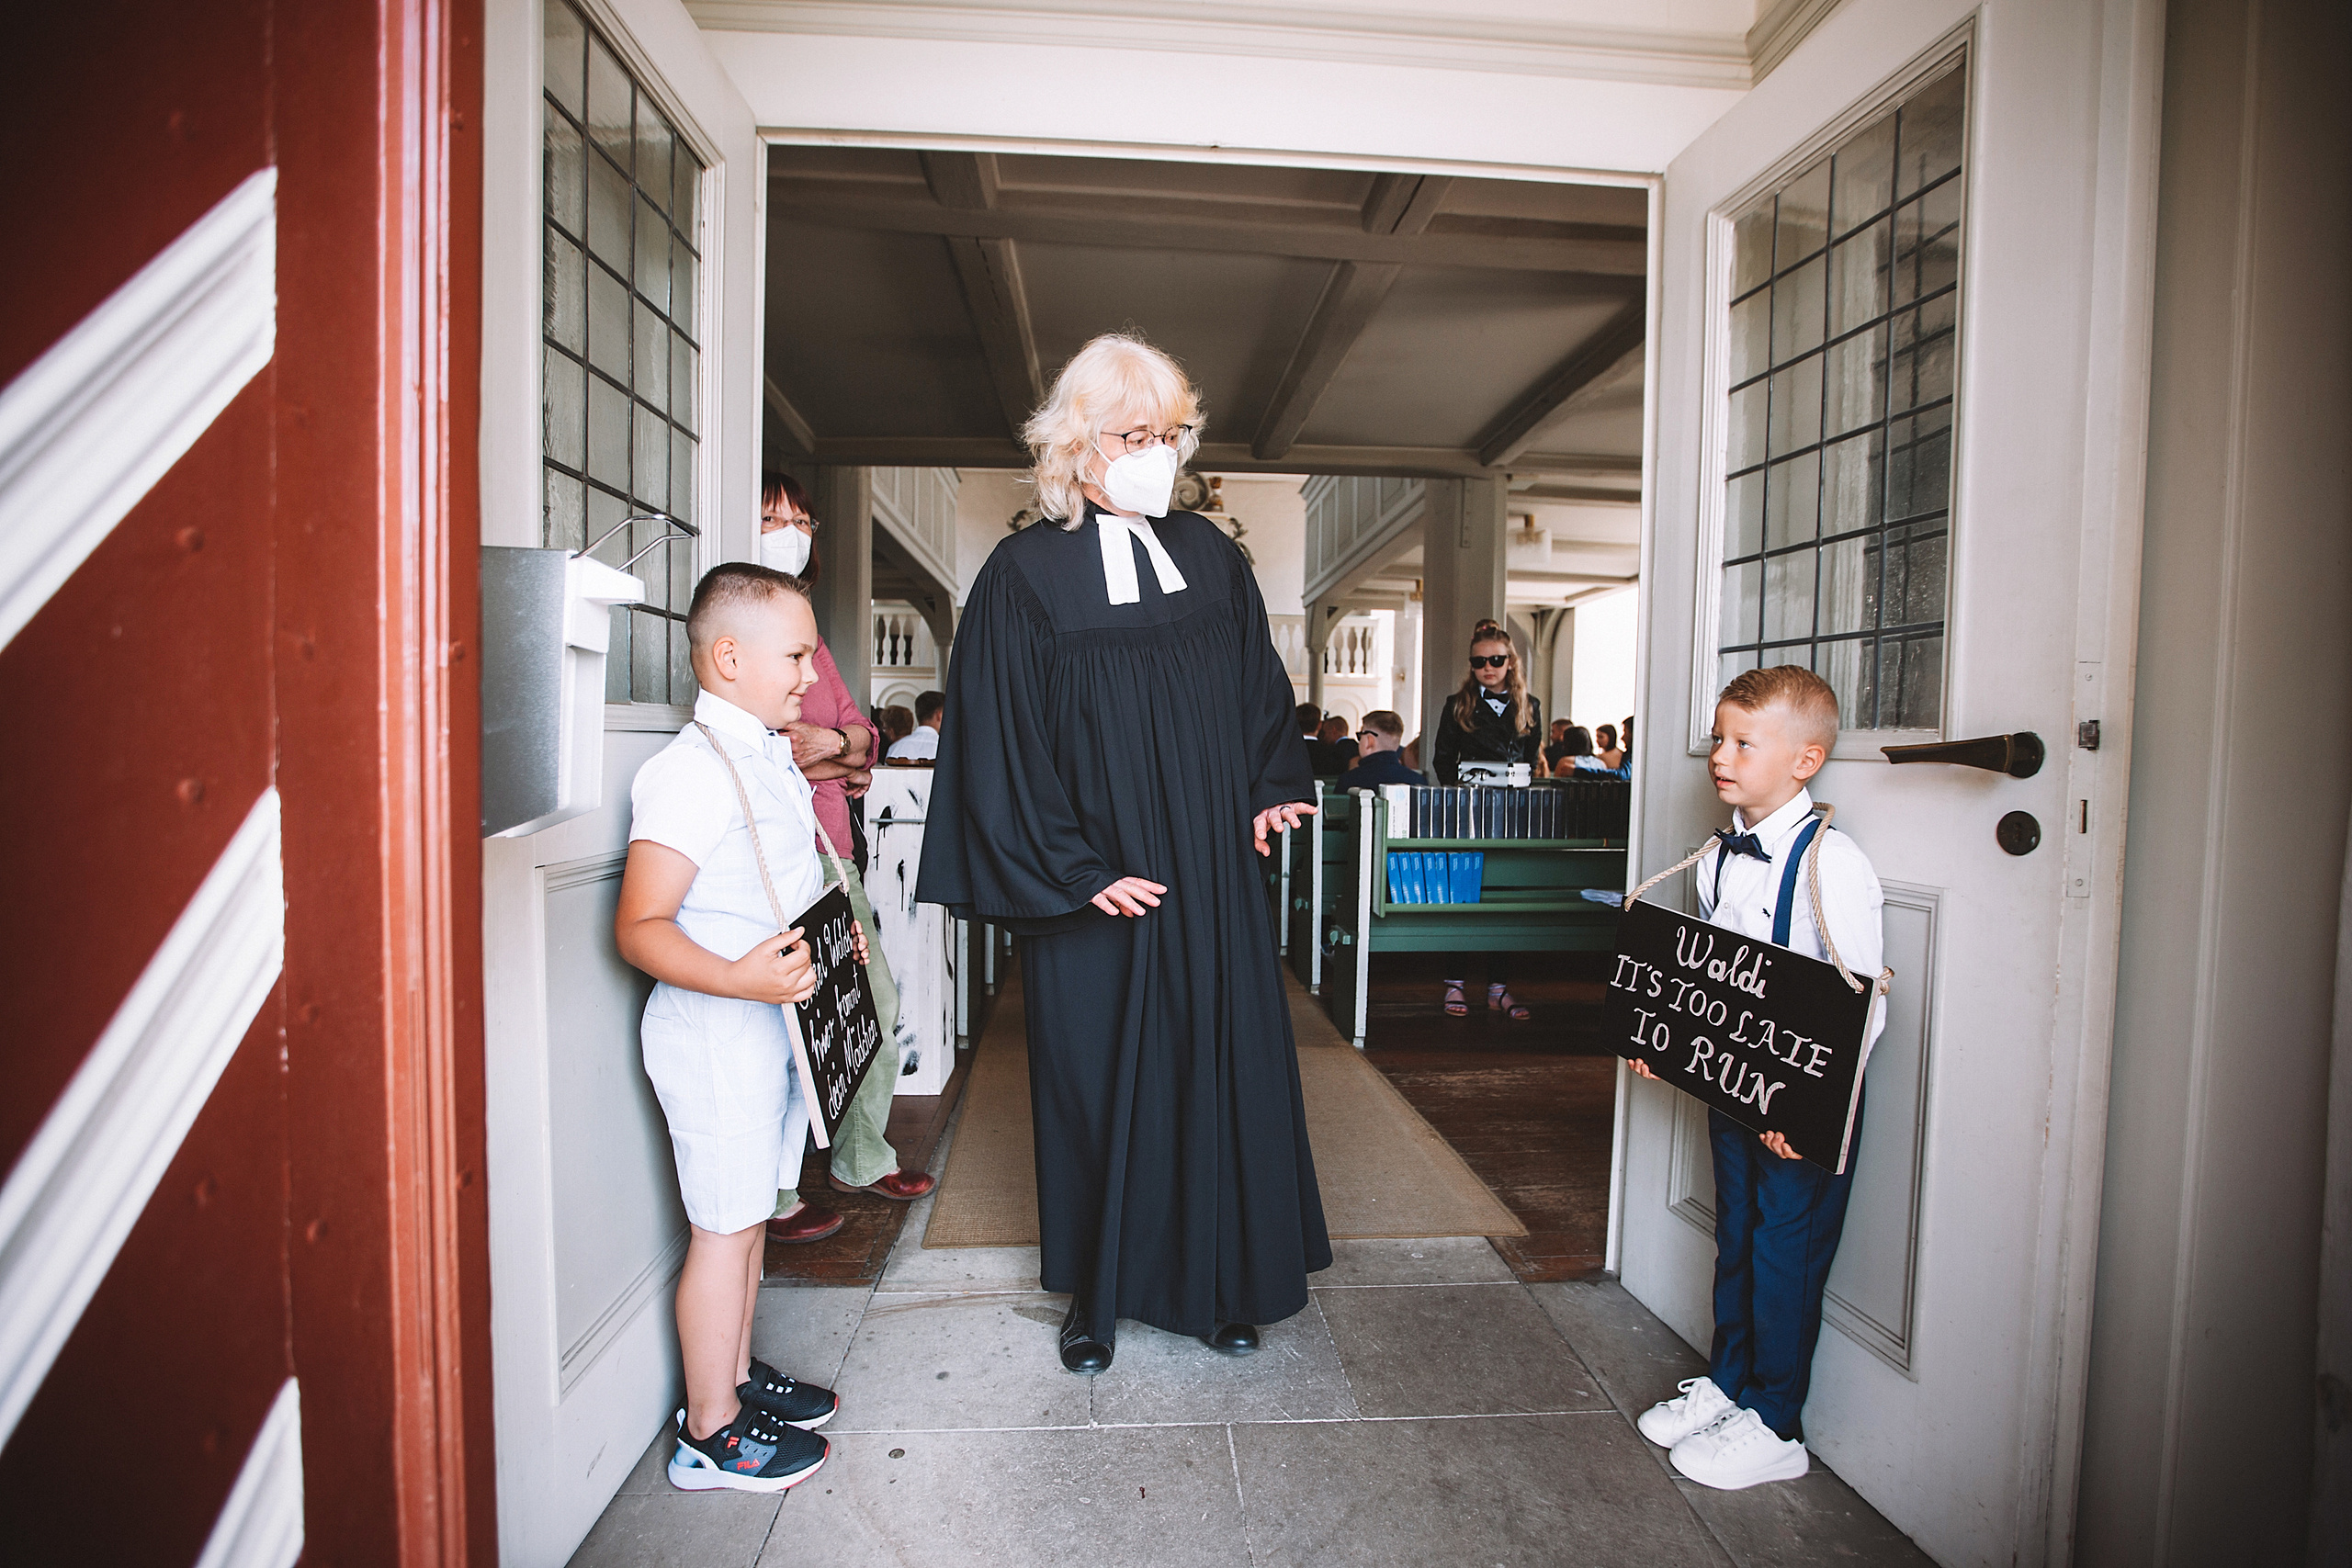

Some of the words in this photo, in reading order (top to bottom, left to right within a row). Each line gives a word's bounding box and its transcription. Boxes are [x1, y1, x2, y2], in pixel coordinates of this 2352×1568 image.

[1677, 926, 1772, 999] Waldi
[809, 1008, 834, 1072] hier
[834, 964, 862, 1031] kommt
[827, 1061, 848, 1120] dein
[843, 1014, 878, 1084] Mädchen
[1611, 954, 1663, 998] IT'S
[1668, 978, 1727, 1027] TOO
[1729, 1011, 1833, 1078] LATE
[1630, 1008, 1670, 1052] TO
[1684, 1036, 1786, 1115] RUN
[737, 1459, 760, 1471] FILA
